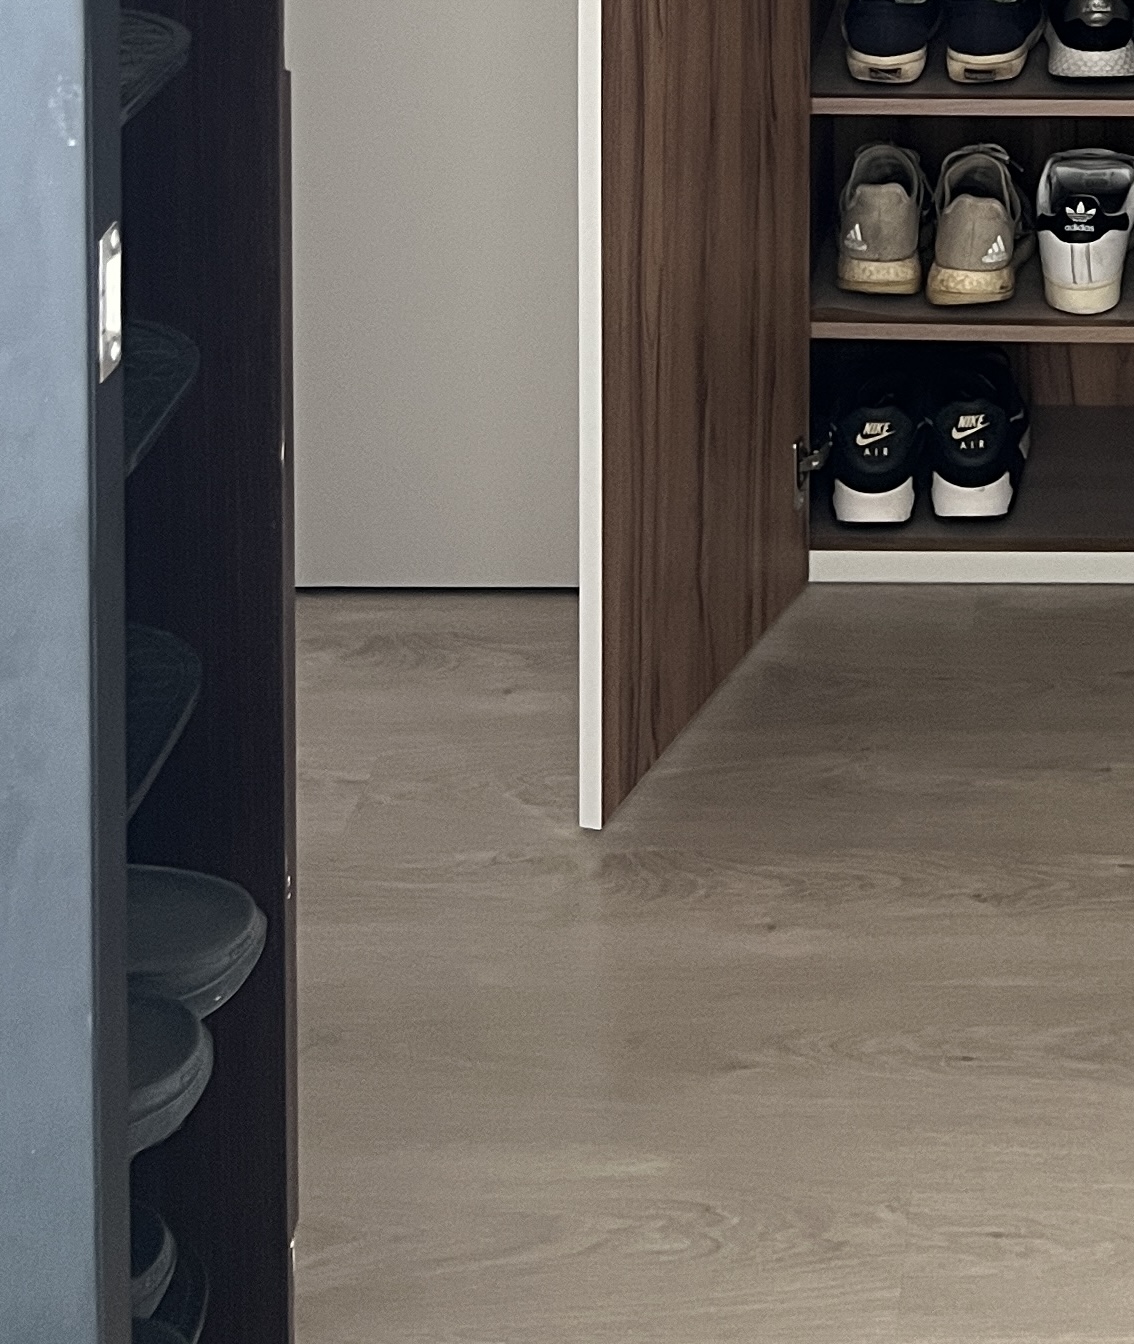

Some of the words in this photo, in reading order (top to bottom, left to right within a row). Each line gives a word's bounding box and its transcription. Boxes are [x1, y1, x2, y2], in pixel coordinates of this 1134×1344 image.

[1064, 223, 1095, 233] adidas
[957, 414, 986, 429] NIKE
[862, 422, 891, 435] NIKE
[960, 439, 984, 449] AIR
[864, 447, 888, 457] AIR
